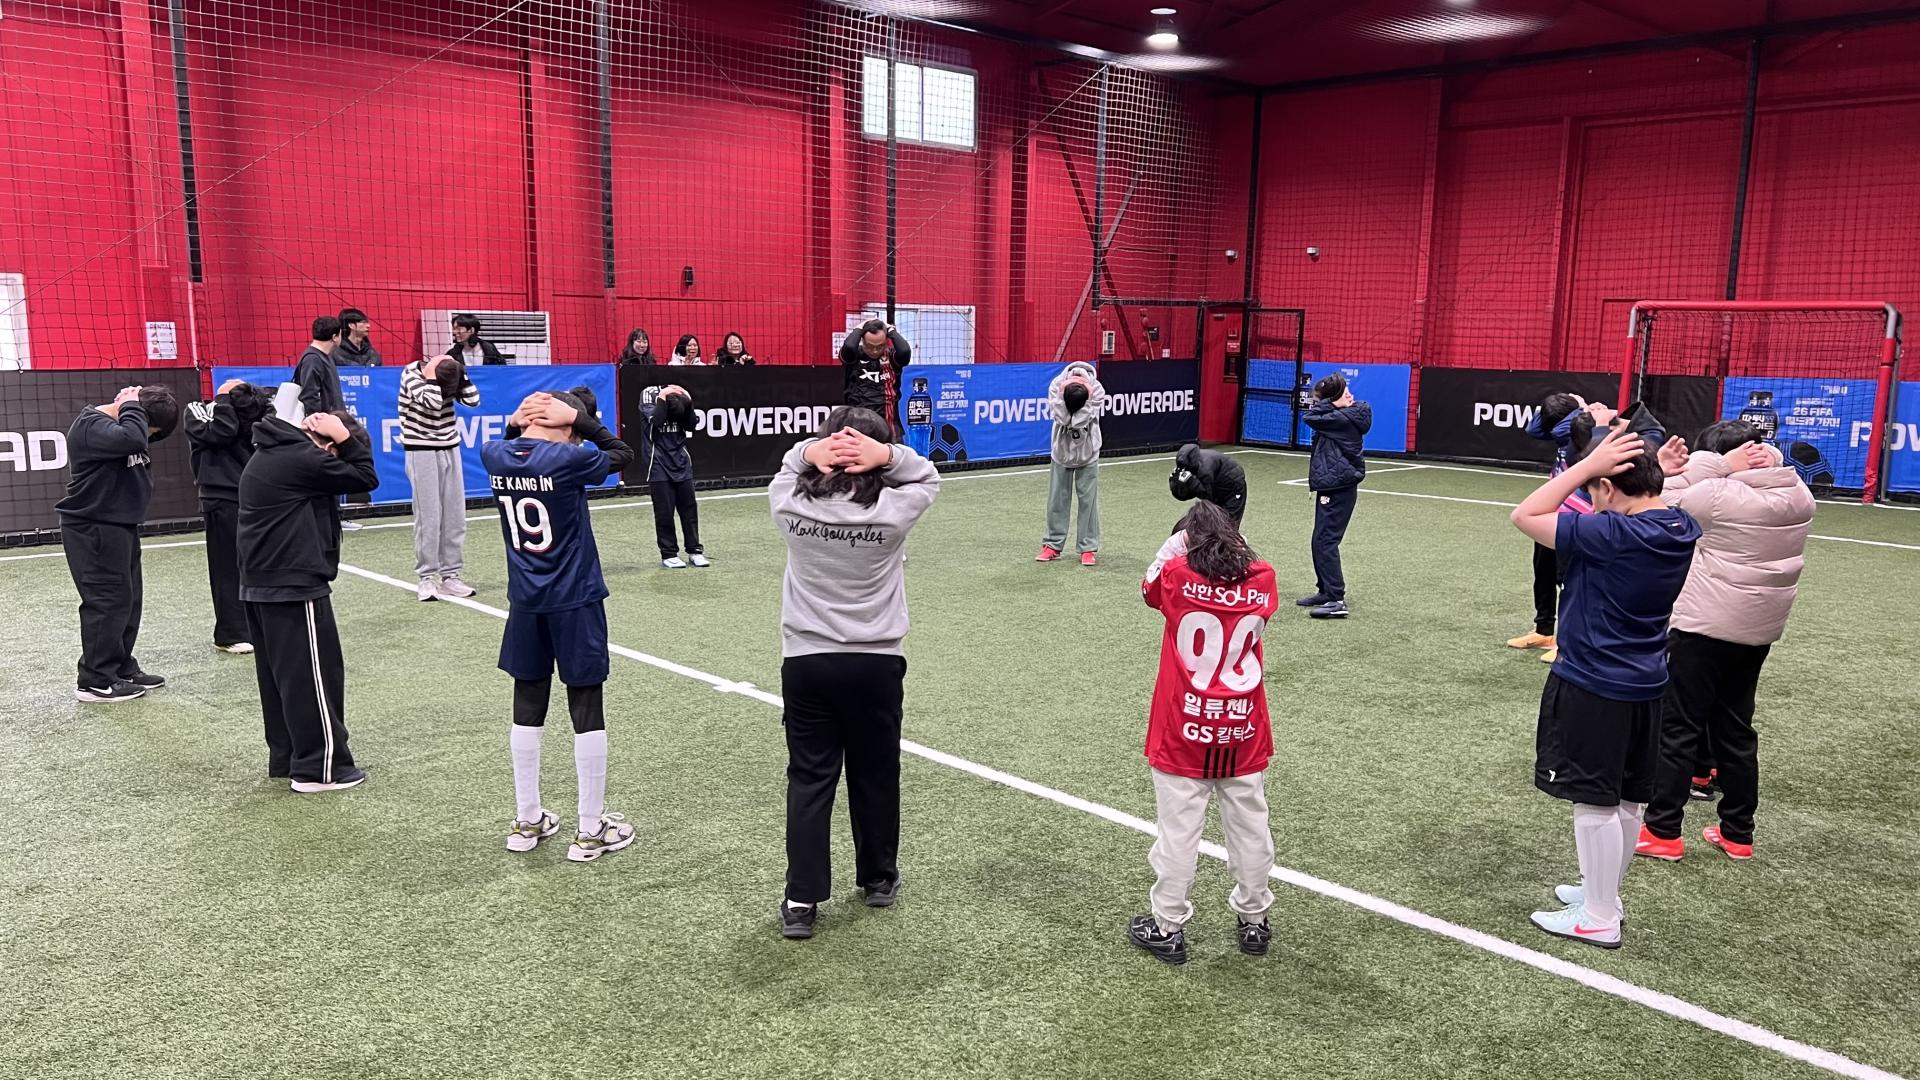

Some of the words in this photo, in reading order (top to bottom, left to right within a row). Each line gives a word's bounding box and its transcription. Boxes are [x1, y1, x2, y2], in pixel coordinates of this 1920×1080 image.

[974, 398, 1054, 424] POWER
[1099, 389, 1194, 417] POWERADE
[1793, 407, 1809, 416] 26
[1809, 407, 1834, 417] FIFA
[685, 405, 840, 438] POWERAD
[506, 475, 537, 492] KANG
[498, 495, 554, 554] 19
[785, 518, 819, 538] Mark
[1182, 581, 1213, 601] 신한
[1247, 588, 1271, 609] Pay
[1183, 691, 1254, 720] 일류첸
[1182, 721, 1214, 744] GS
[1216, 720, 1256, 744] 칼텍스
